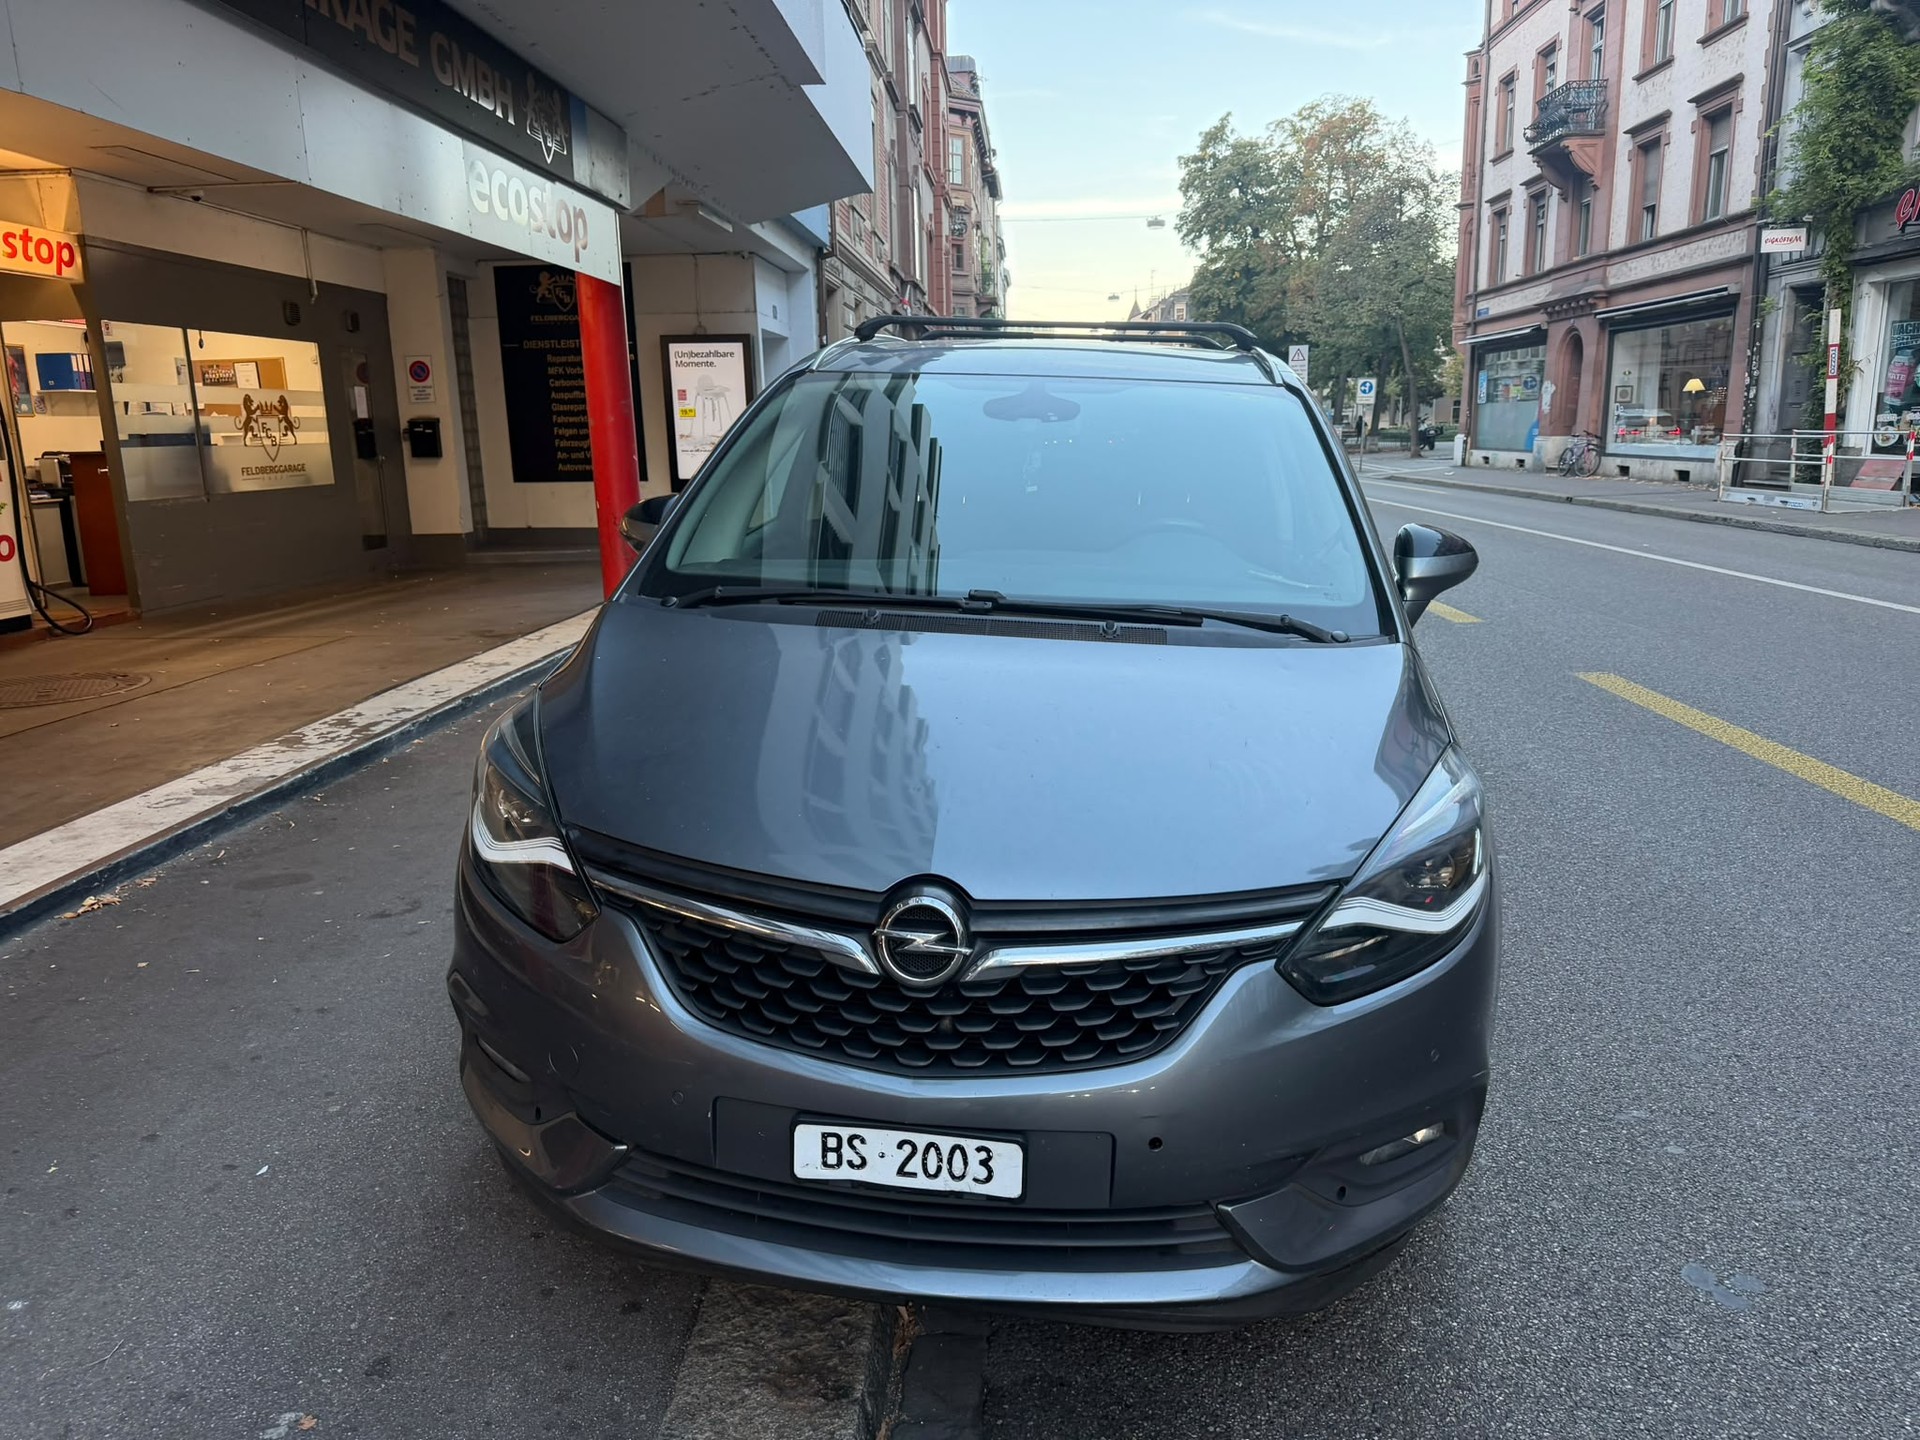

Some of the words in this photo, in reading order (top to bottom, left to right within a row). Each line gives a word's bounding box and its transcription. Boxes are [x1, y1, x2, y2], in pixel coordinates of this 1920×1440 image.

[429, 31, 516, 126] GMBH
[469, 159, 589, 264] ecostop
[1, 227, 76, 277] stop
[674, 349, 735, 360] (Un)bezahlbare
[675, 360, 717, 368] Momente.
[241, 463, 307, 477] FELDBERGGARAGE
[821, 1131, 868, 1171] BS
[896, 1138, 995, 1185] 2003
